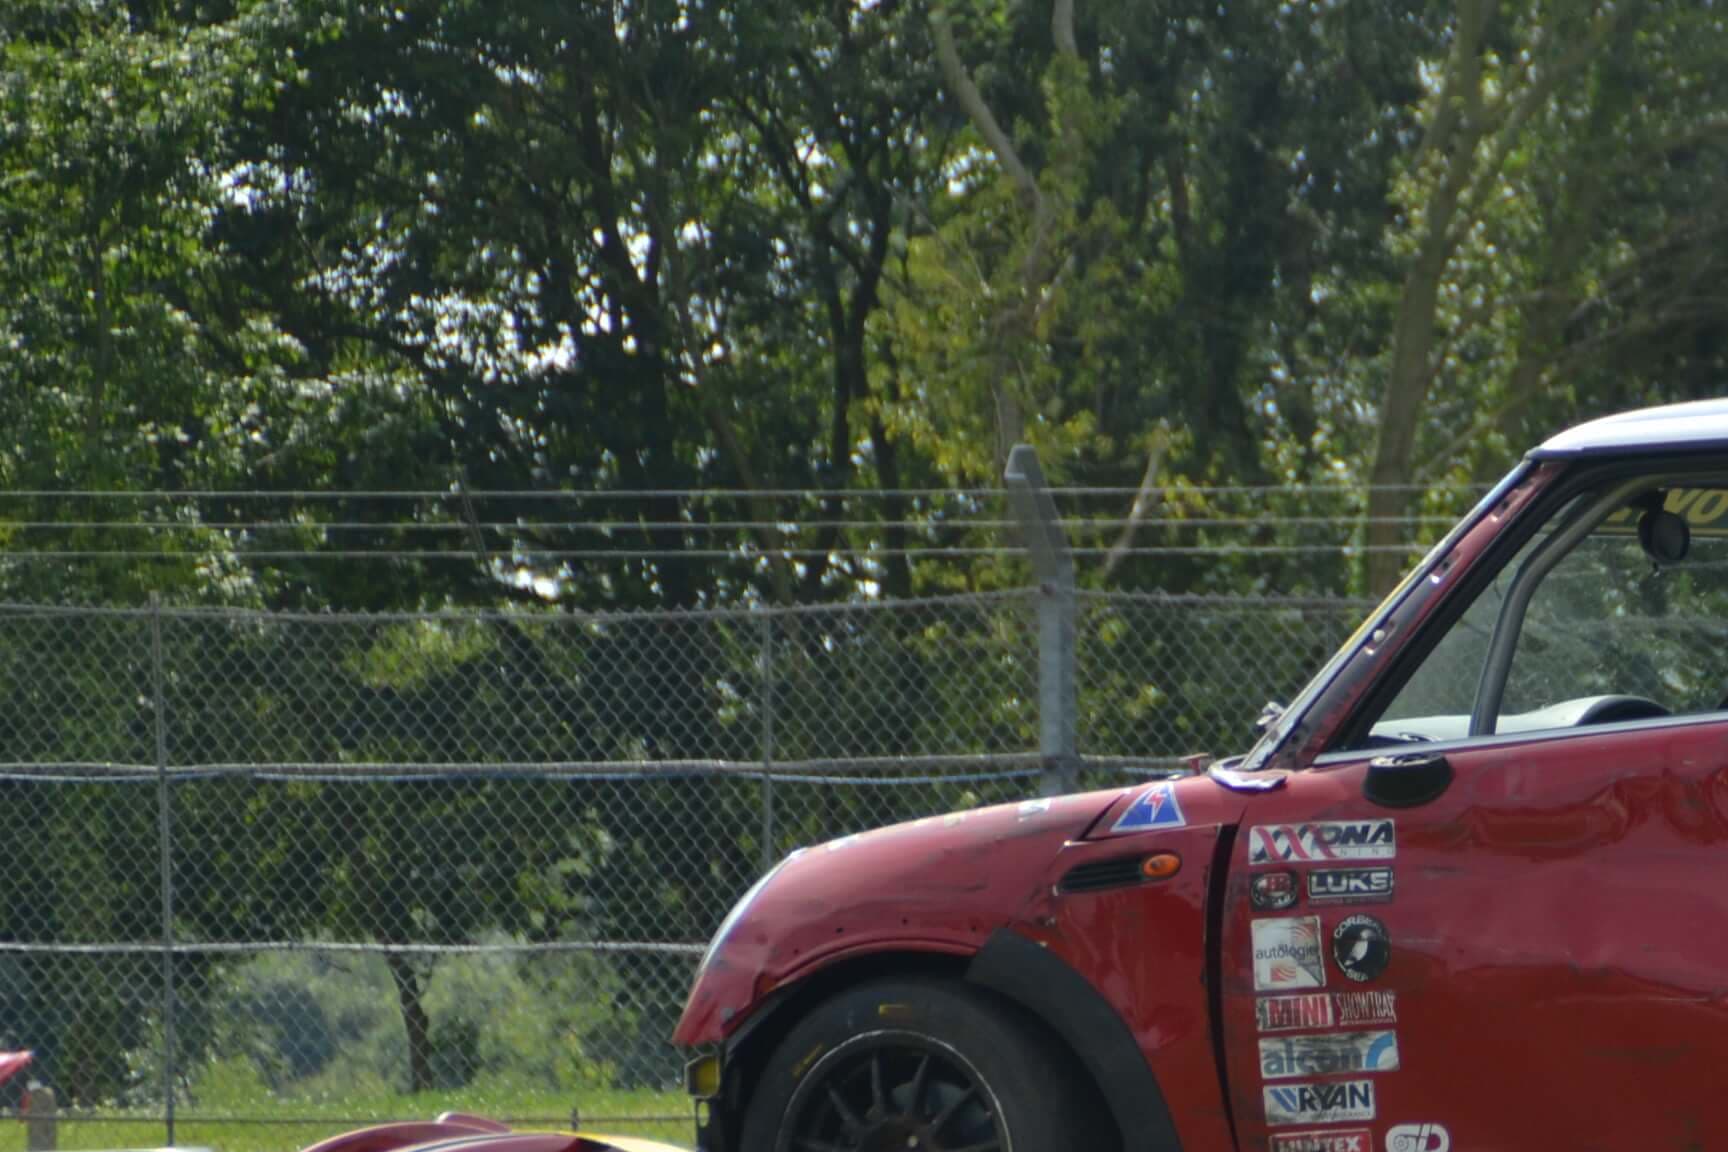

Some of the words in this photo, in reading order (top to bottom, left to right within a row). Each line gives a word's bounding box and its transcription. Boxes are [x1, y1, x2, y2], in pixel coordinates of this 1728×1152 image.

[1267, 994, 1330, 1026] MINI
[1336, 990, 1397, 1023] SHOWTRAX
[1299, 1082, 1371, 1113] RYAN
